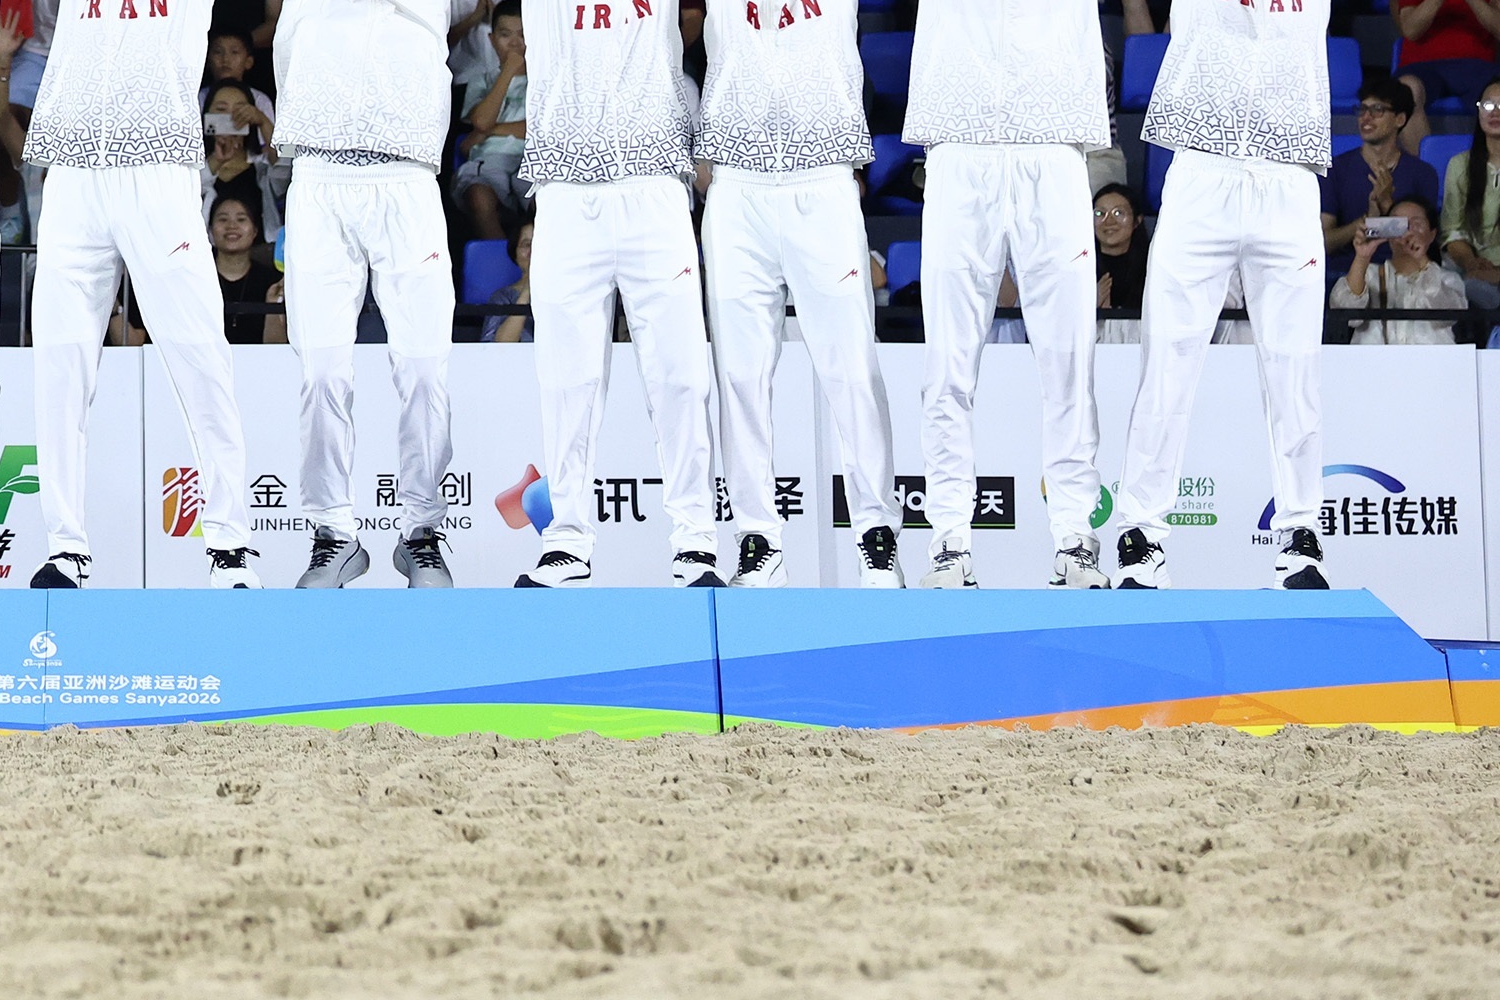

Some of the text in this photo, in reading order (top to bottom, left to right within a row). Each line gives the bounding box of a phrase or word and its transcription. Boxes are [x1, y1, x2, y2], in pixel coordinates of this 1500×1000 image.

[1182, 500, 1214, 510] share
[1171, 515, 1212, 525] 870981
[1251, 534, 1273, 545] Hai
[0, 692, 53, 705] Beach
[59, 692, 119, 705] Games
[125, 692, 221, 707] Sanya2026
